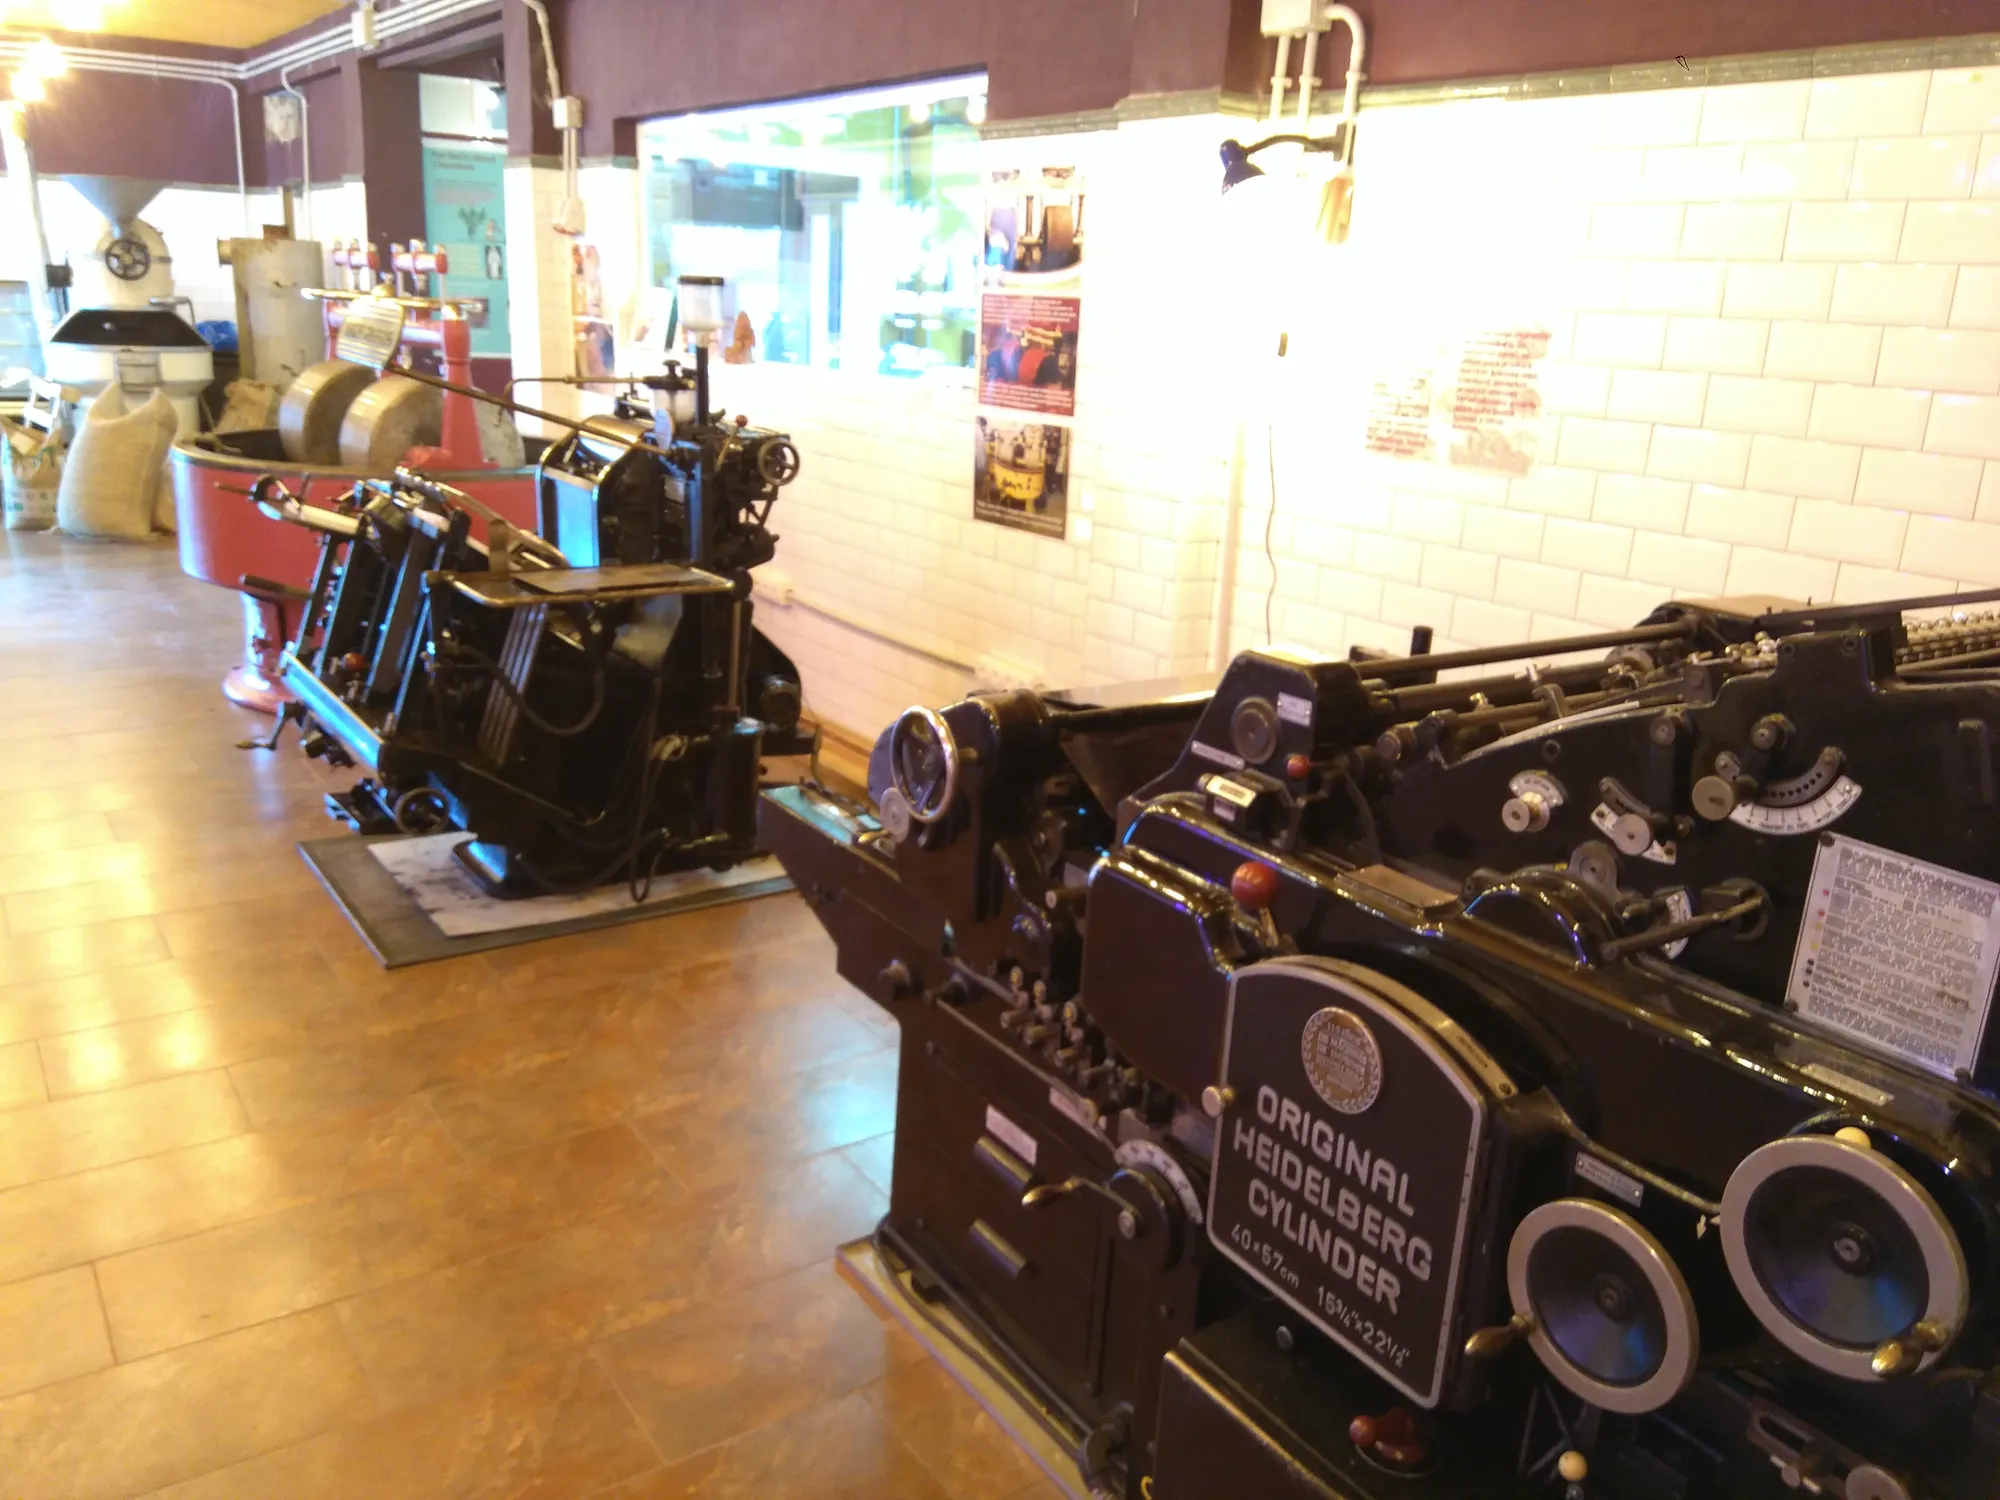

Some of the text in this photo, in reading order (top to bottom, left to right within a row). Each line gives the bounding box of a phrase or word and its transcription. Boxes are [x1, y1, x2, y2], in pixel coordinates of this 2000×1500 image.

[1233, 1117, 1432, 1281] HEIDELBERG
[1257, 1085, 1415, 1217] ORIGINAL
[1249, 1178, 1401, 1315] CYLINDER
